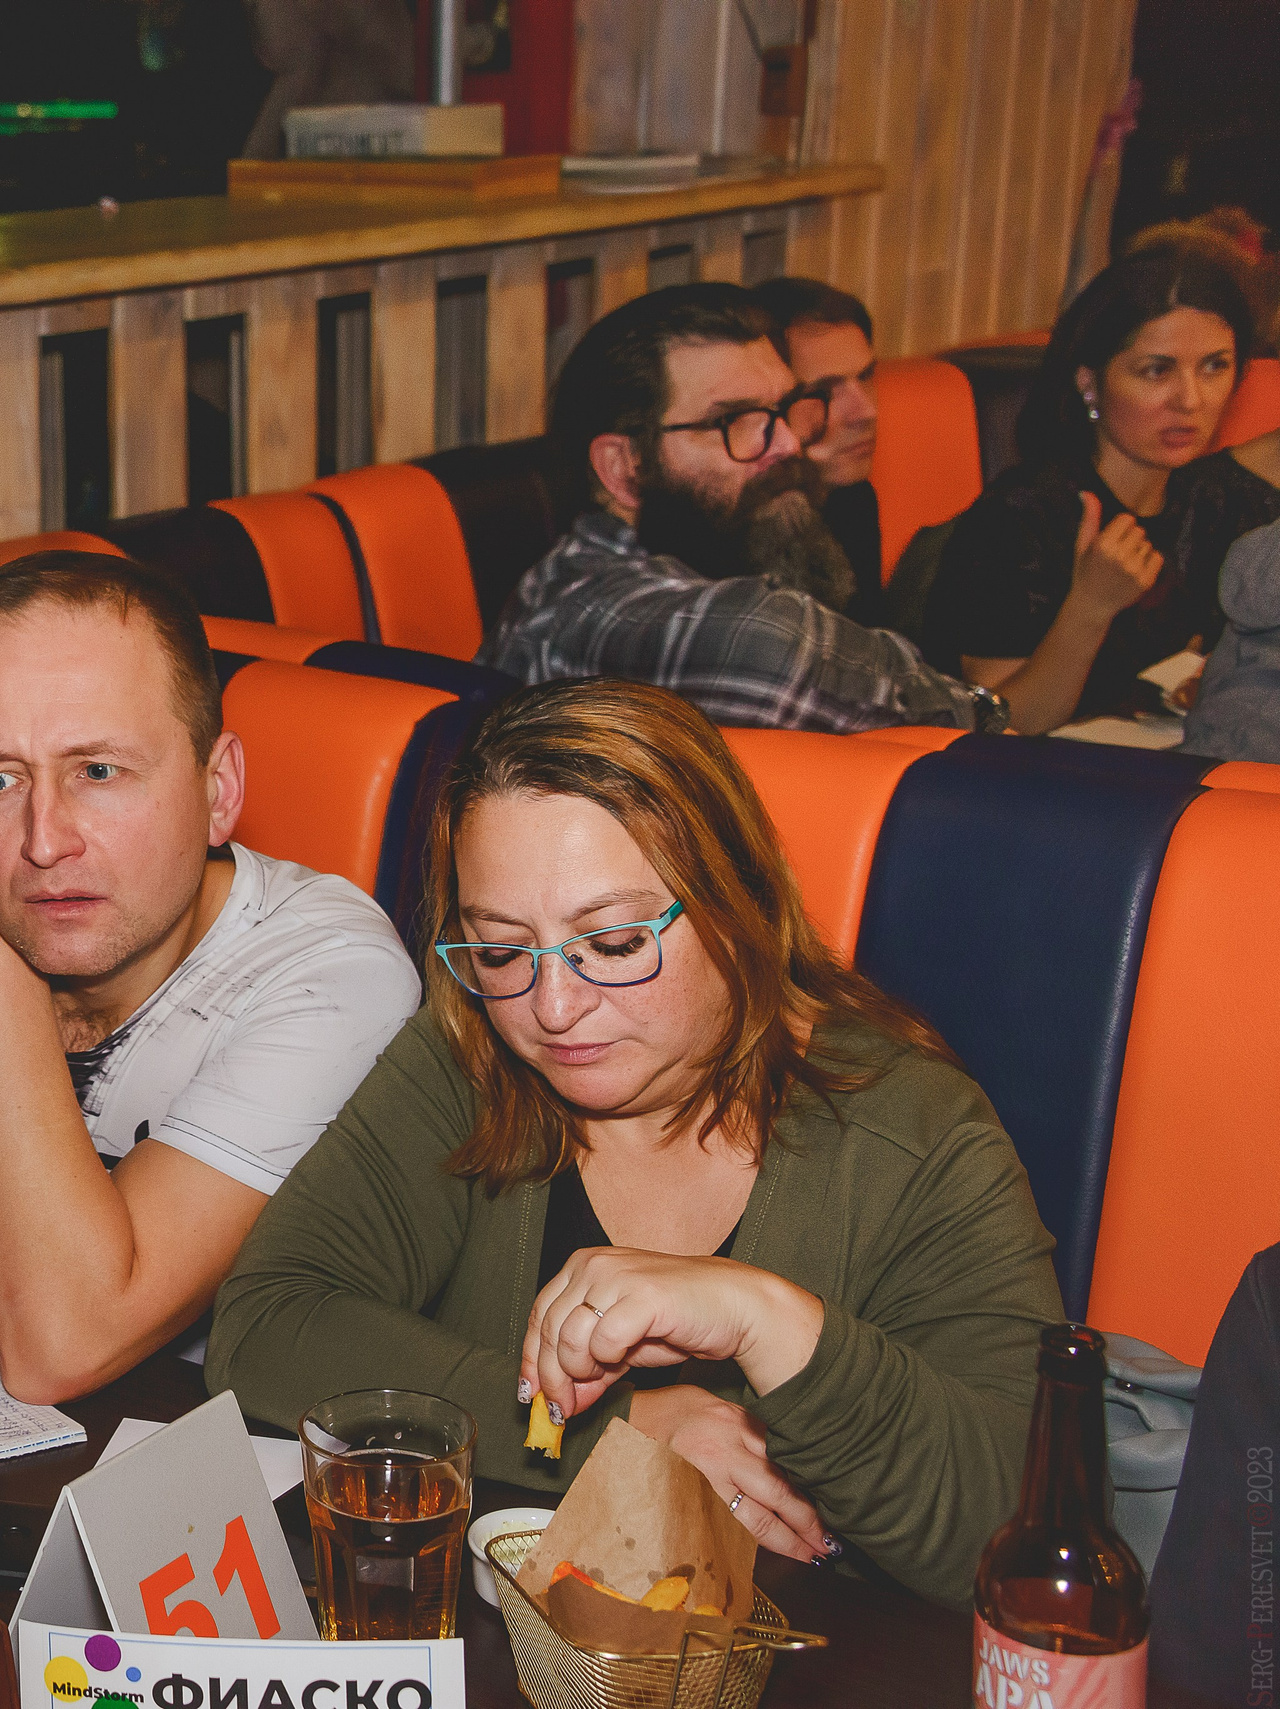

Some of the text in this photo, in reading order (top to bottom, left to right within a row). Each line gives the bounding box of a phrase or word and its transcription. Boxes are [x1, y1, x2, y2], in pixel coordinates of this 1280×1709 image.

[138, 1515, 282, 1640] 51
[979, 1636, 1051, 1686] JAWS
[52, 1681, 145, 1703] MindStorm
[151, 1673, 432, 1709] ФИАСКО
